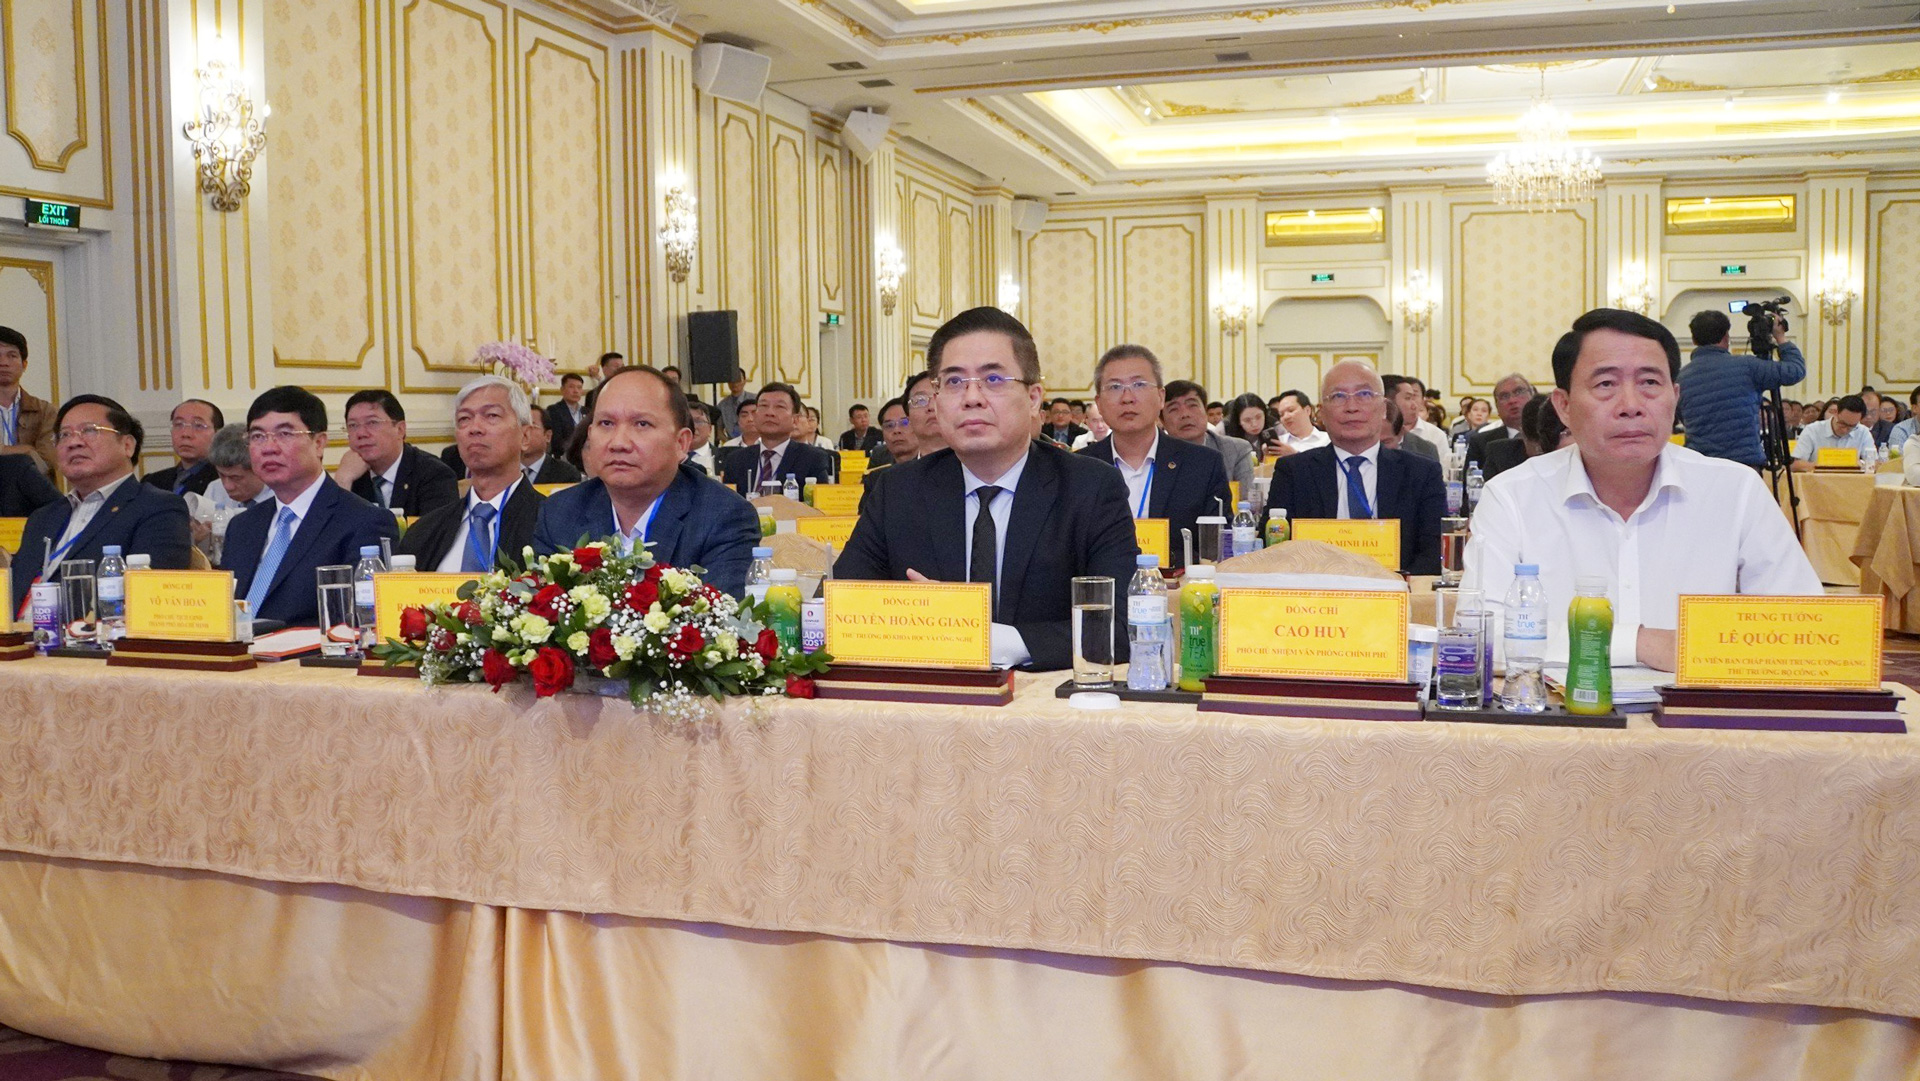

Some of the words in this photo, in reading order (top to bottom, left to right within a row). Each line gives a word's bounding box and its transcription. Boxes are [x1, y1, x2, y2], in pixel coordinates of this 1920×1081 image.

[42, 203, 67, 216] EXIT
[419, 586, 440, 595] ĐỒNG
[441, 586, 455, 595] CHÍ
[883, 597, 910, 606] ĐỒNG
[912, 597, 930, 606] CHÍ
[1285, 604, 1316, 615] ĐỒNG
[1319, 604, 1338, 615] CHÍ
[835, 612, 886, 625] NGUYỄN
[890, 613, 935, 627] HOÀNG
[938, 617, 980, 628] GIANG
[1737, 612, 1777, 622] TRUNG
[1781, 611, 1823, 622] TƯỚNG
[1517, 620, 1536, 629] true
[786, 626, 795, 635] TH
[1190, 626, 1199, 635] TH
[1274, 625, 1310, 638] CAO
[1314, 626, 1350, 639] HUY
[1189, 635, 1206, 647] true
[1719, 629, 1739, 644] LÊ
[1743, 630, 1790, 647] QUỐC
[1794, 630, 1840, 645] HÙNG
[1189, 646, 1207, 659] TEA
[1272, 648, 1297, 657] NHIỆM
[1298, 647, 1315, 656] VĂN
[1316, 648, 1344, 657] PHÒNG
[1345, 649, 1371, 658] CHÍNH
[1725, 657, 1742, 665] BAN
[1789, 659, 1817, 667] TRUNG
[1794, 668, 1818, 677] CÔNG
[1819, 669, 1830, 677] AN
